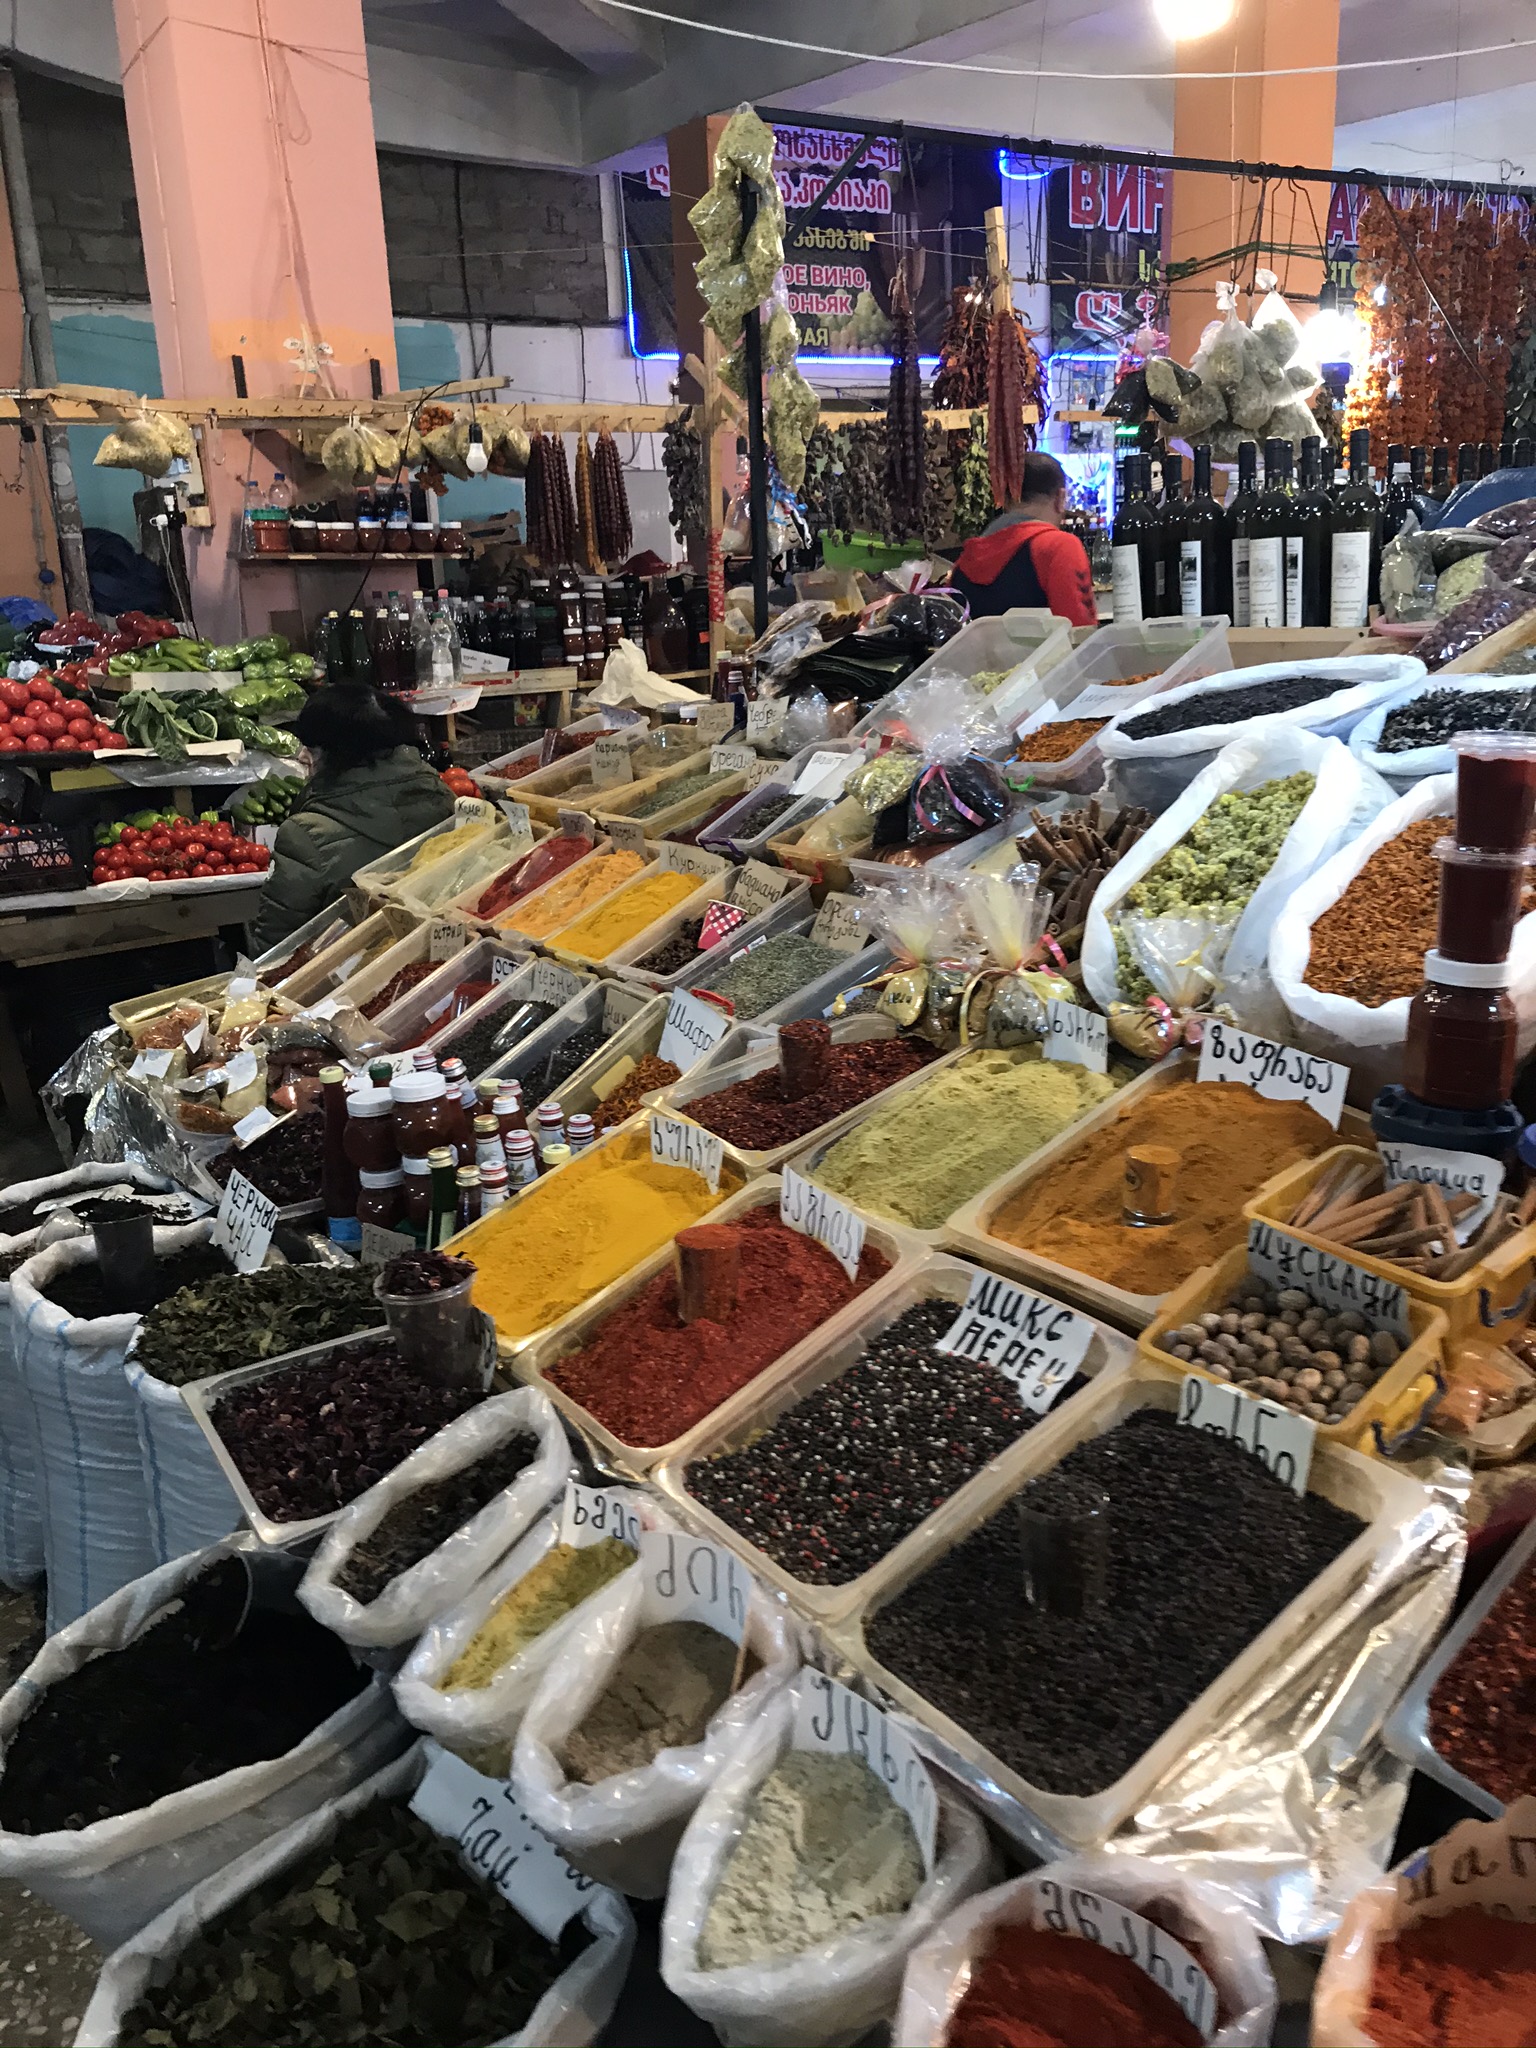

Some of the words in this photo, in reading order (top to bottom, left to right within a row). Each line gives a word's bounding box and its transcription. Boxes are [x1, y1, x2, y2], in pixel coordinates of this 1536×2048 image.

[811, 266, 870, 291] ВИНО,
[788, 294, 853, 316] ОНЬЯК
[1211, 1024, 1333, 1094] ზაფრანა
[967, 1275, 1075, 1342] МИКС
